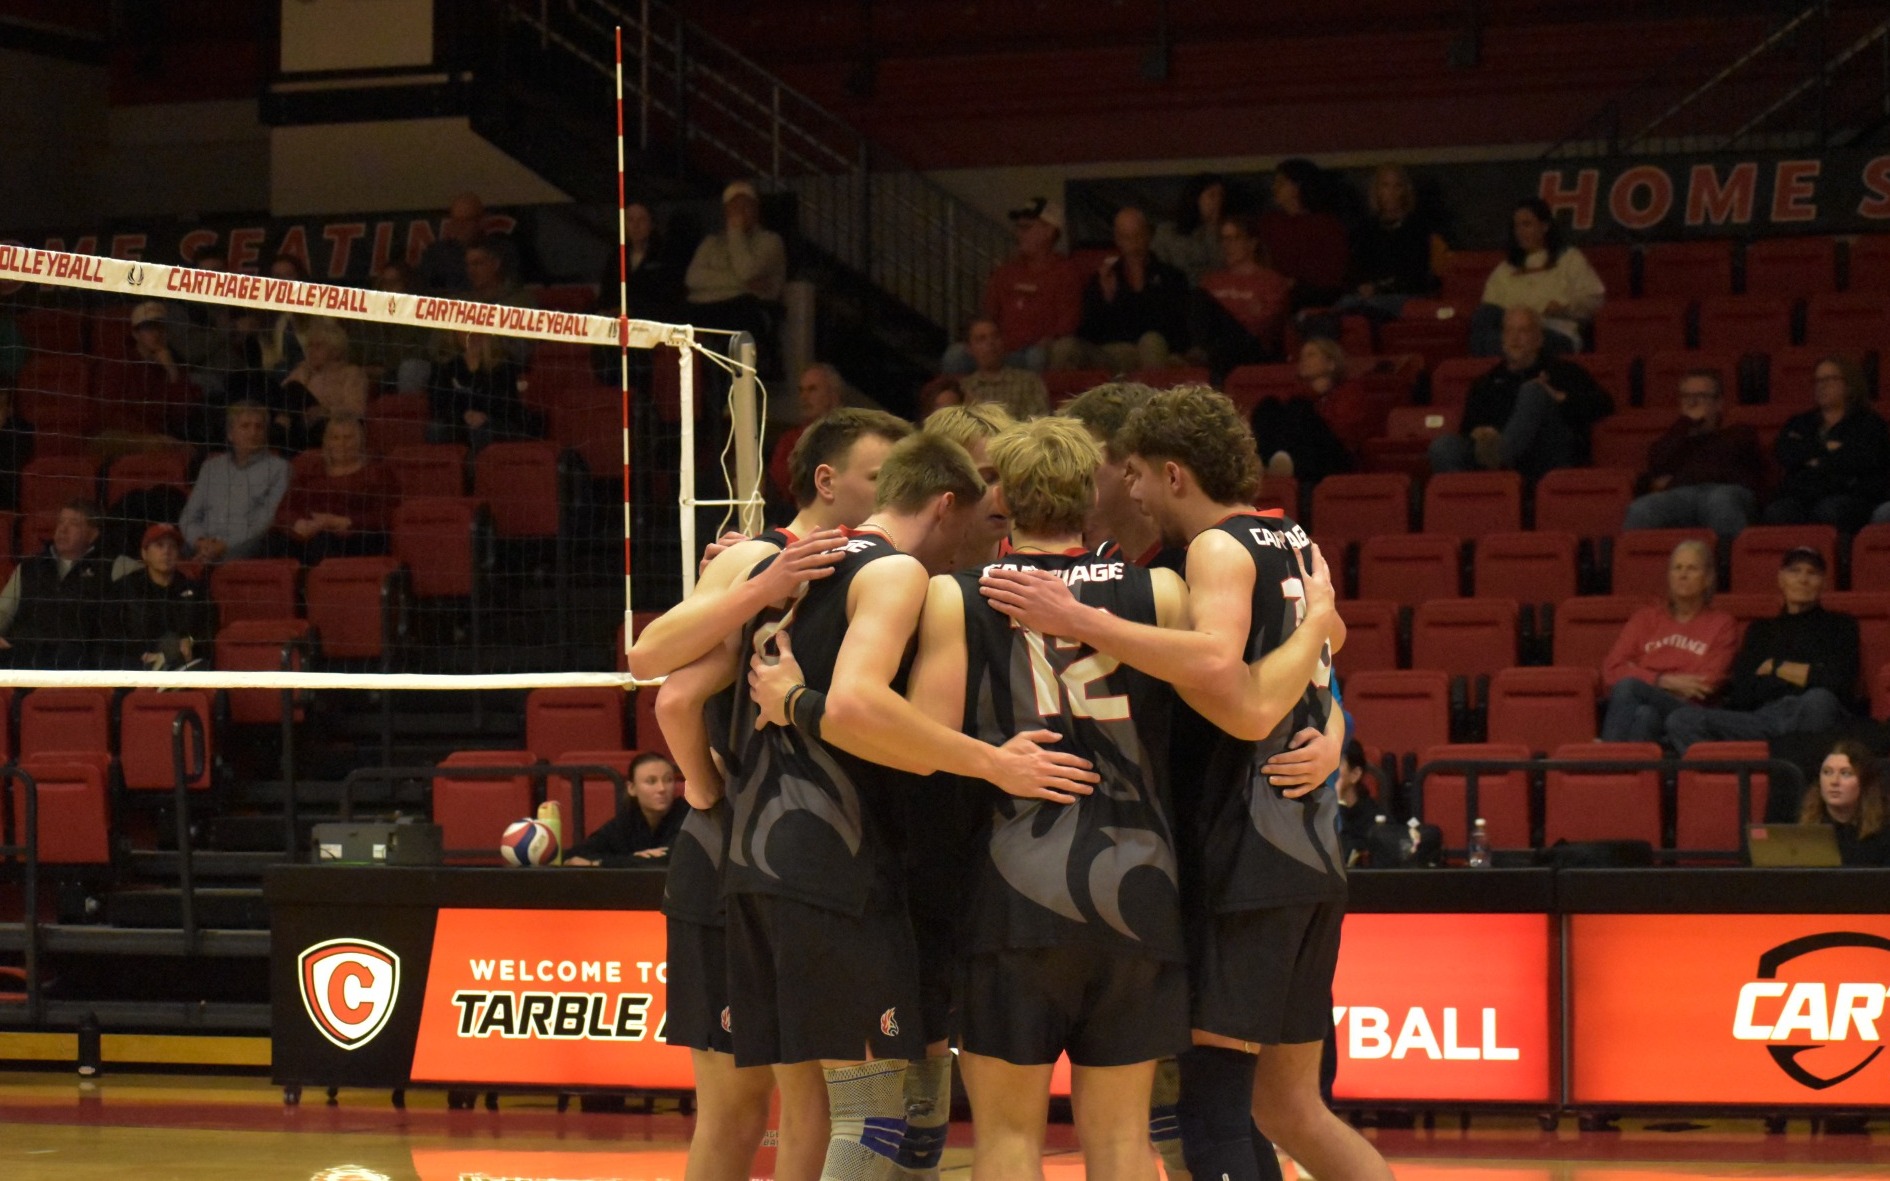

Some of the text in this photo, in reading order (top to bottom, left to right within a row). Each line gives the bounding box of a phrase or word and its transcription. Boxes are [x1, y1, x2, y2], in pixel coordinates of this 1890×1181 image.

[1538, 160, 1821, 230] HOME
[166, 267, 368, 313] CARTHAGE VOLLEYBALL
[415, 298, 588, 337] CARTHAGE VOLLEYBALL
[1009, 606, 1133, 721] 12
[469, 958, 626, 983] WELCOME
[451, 990, 653, 1041] TARBLE
[1732, 982, 1890, 1041] CAR
